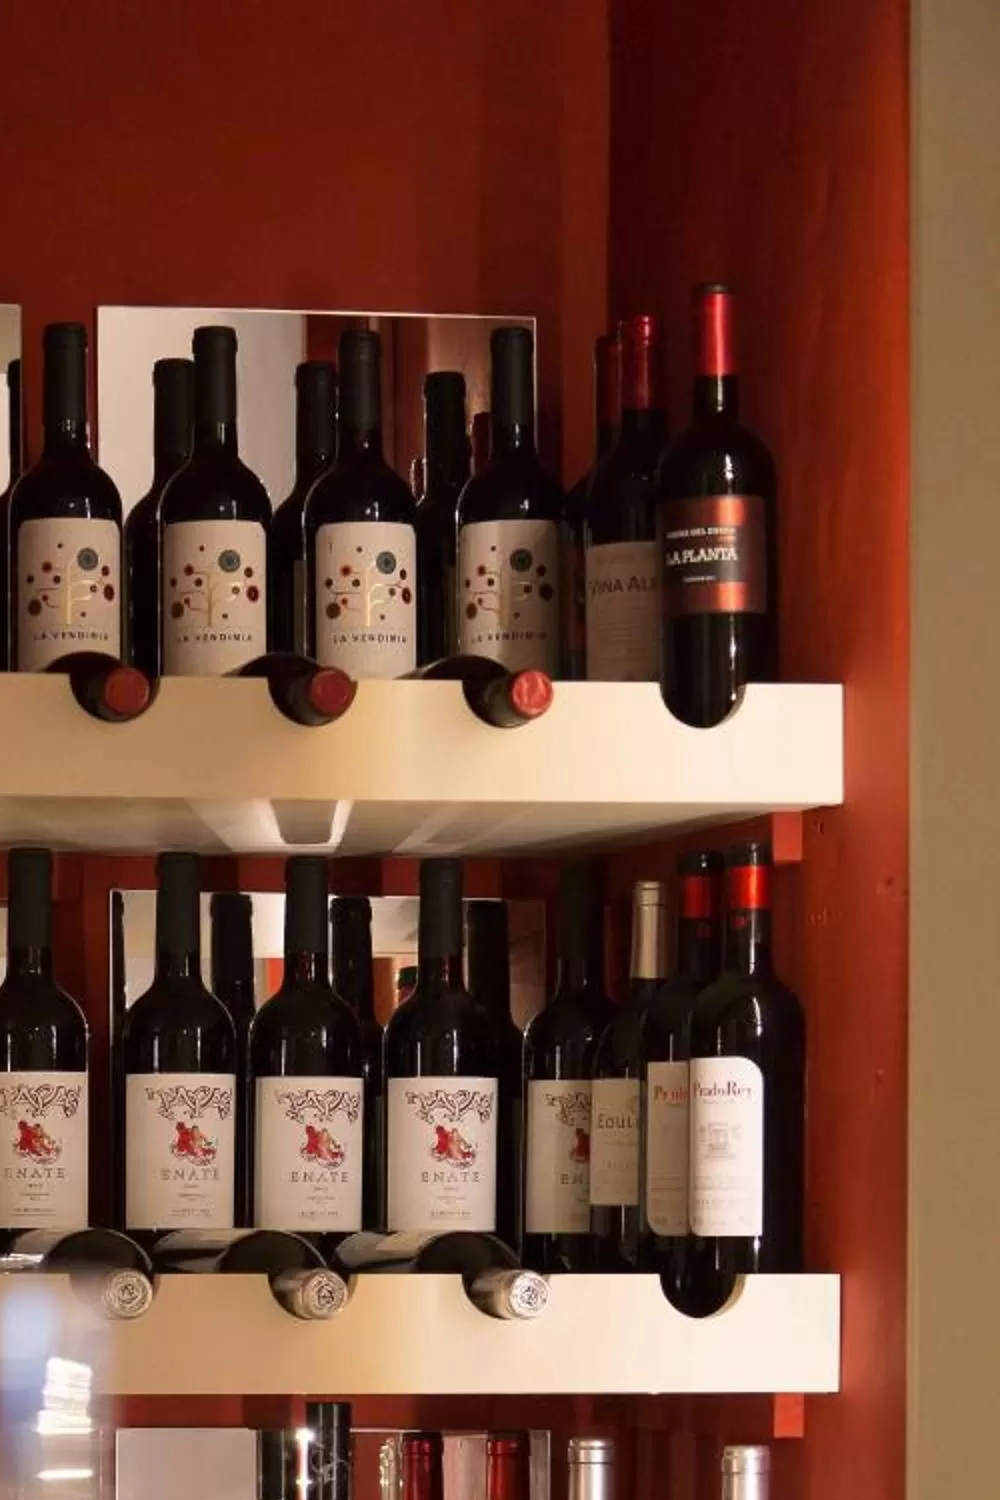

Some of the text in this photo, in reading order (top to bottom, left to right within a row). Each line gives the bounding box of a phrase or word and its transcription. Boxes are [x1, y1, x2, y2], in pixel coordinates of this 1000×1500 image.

[682, 546, 739, 563] PLANTA
[351, 634, 408, 645] VENDIMIA
[3, 1167, 66, 1180] ENATE
[159, 1168, 220, 1181] ENATE
[289, 1171, 350, 1183] ENATE
[420, 1171, 481, 1183] ENATE
